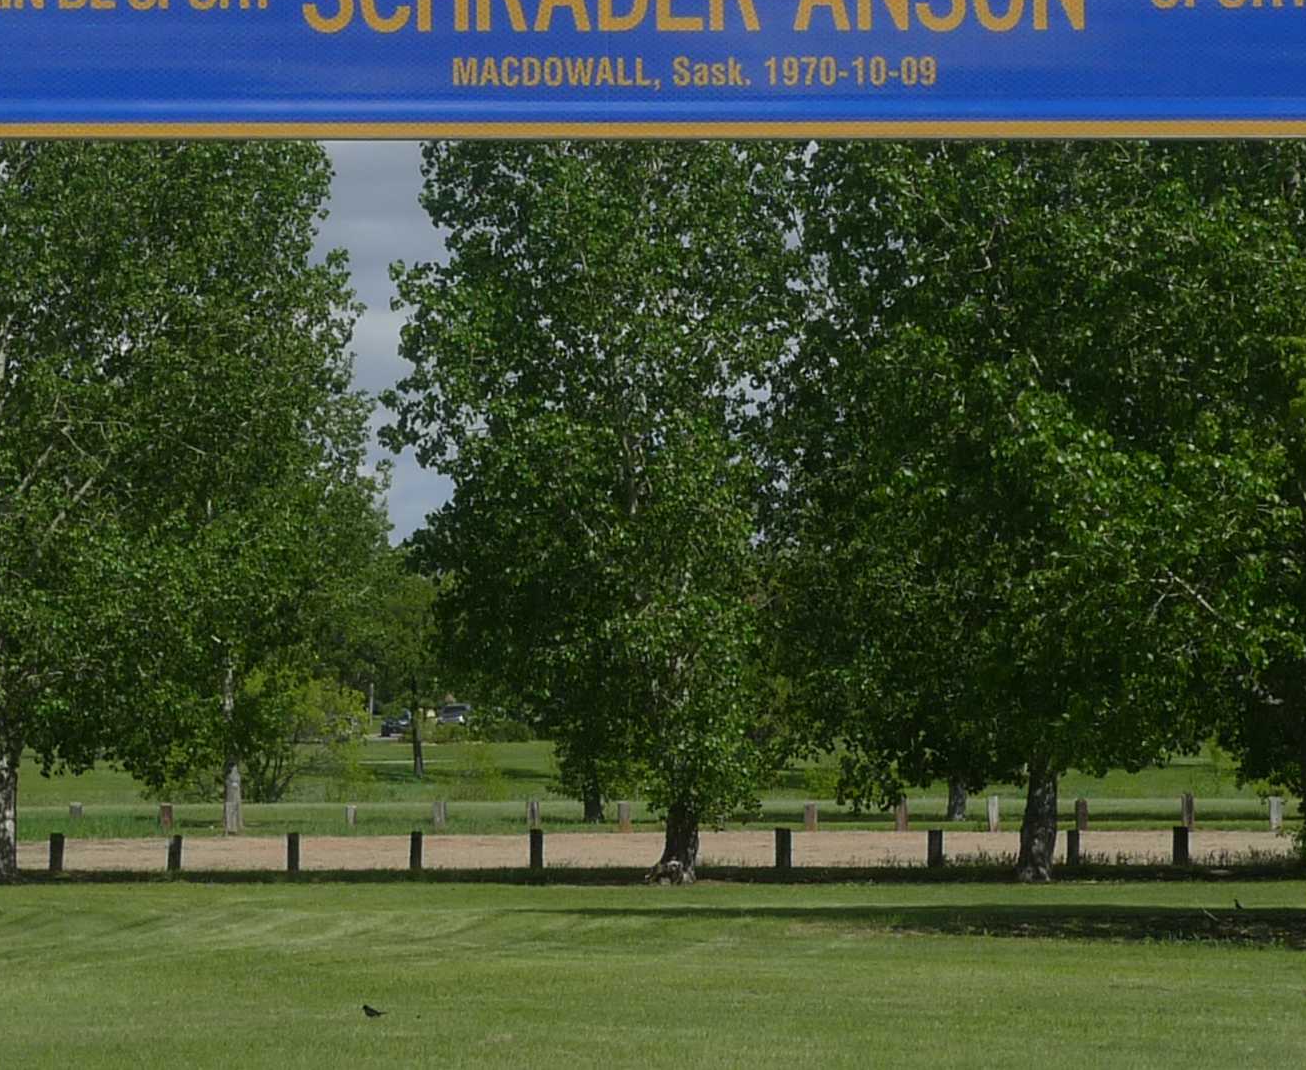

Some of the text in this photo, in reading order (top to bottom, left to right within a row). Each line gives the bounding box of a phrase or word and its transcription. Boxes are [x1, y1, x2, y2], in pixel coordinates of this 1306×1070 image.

[452, 55, 938, 91] MACDOWALL, Sask. 1970-10-09
